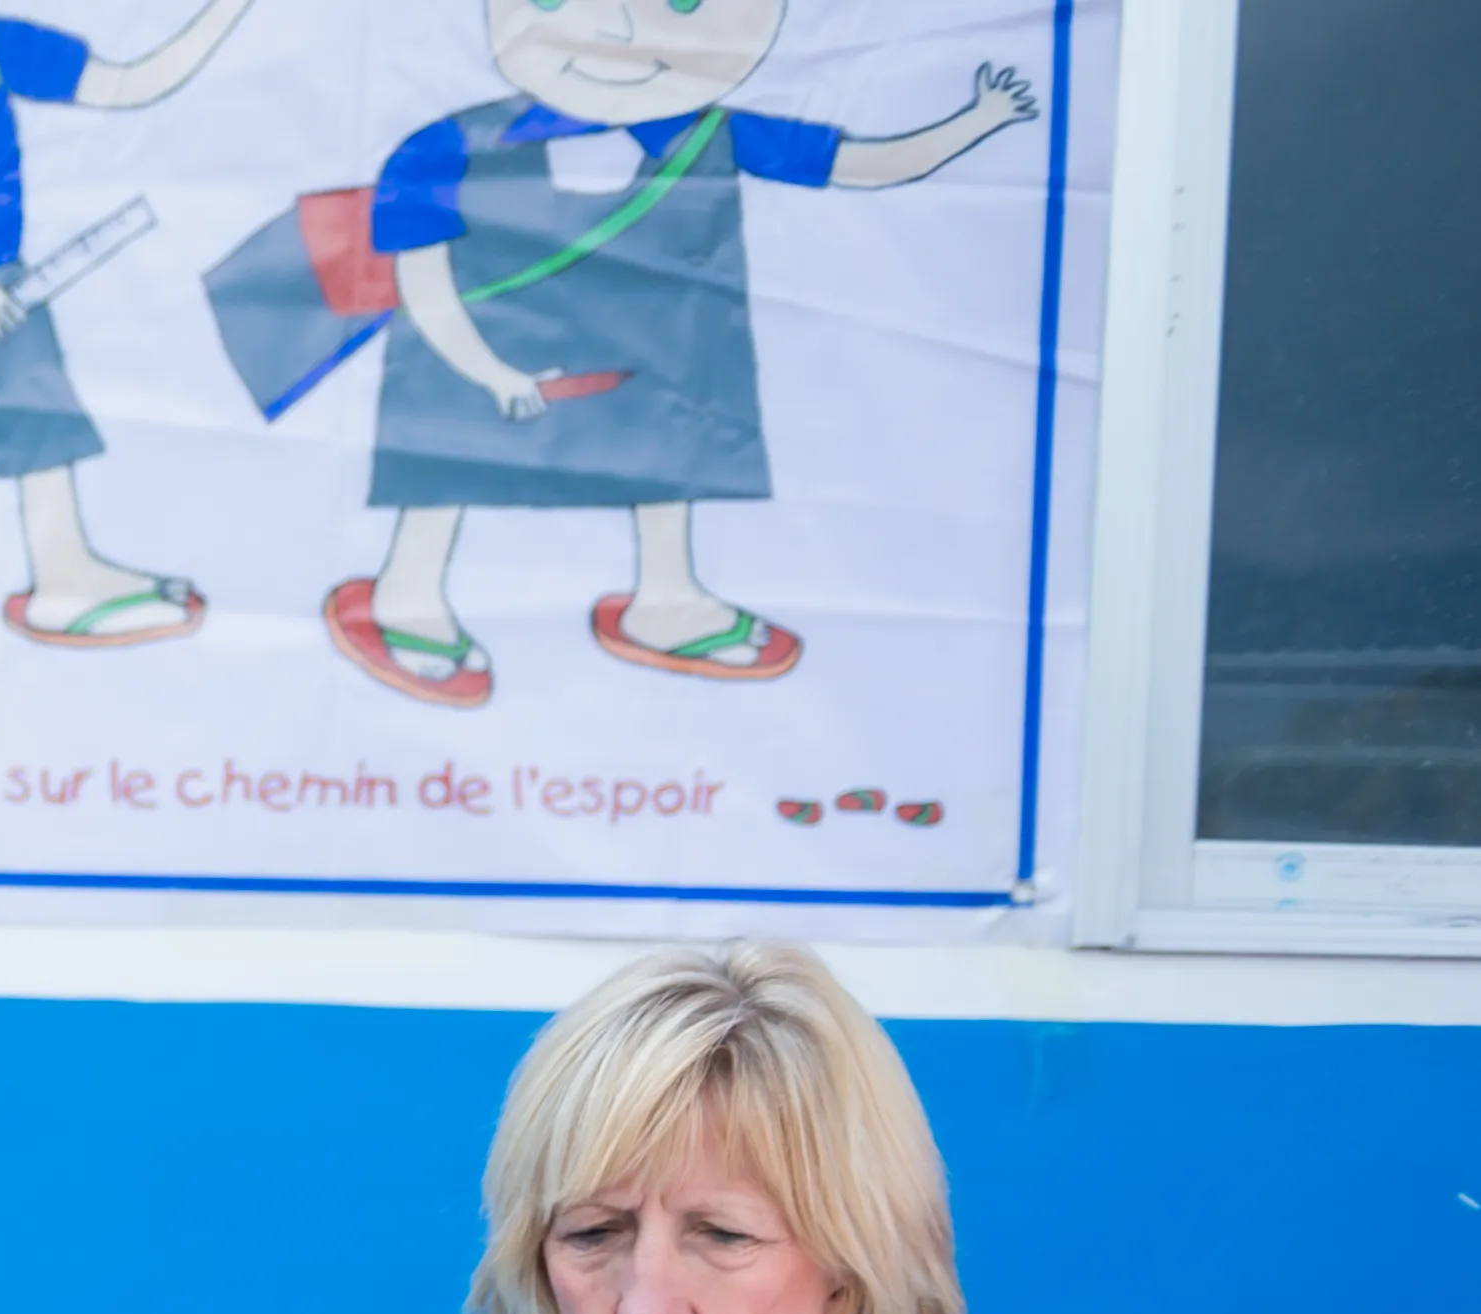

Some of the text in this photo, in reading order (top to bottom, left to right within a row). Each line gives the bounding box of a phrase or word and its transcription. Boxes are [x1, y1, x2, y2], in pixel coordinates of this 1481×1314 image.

[4, 763, 94, 806] sur
[109, 757, 158, 810] le
[174, 757, 399, 812] chemin
[417, 759, 493, 816] de
[512, 763, 726, 826] l'espoir
